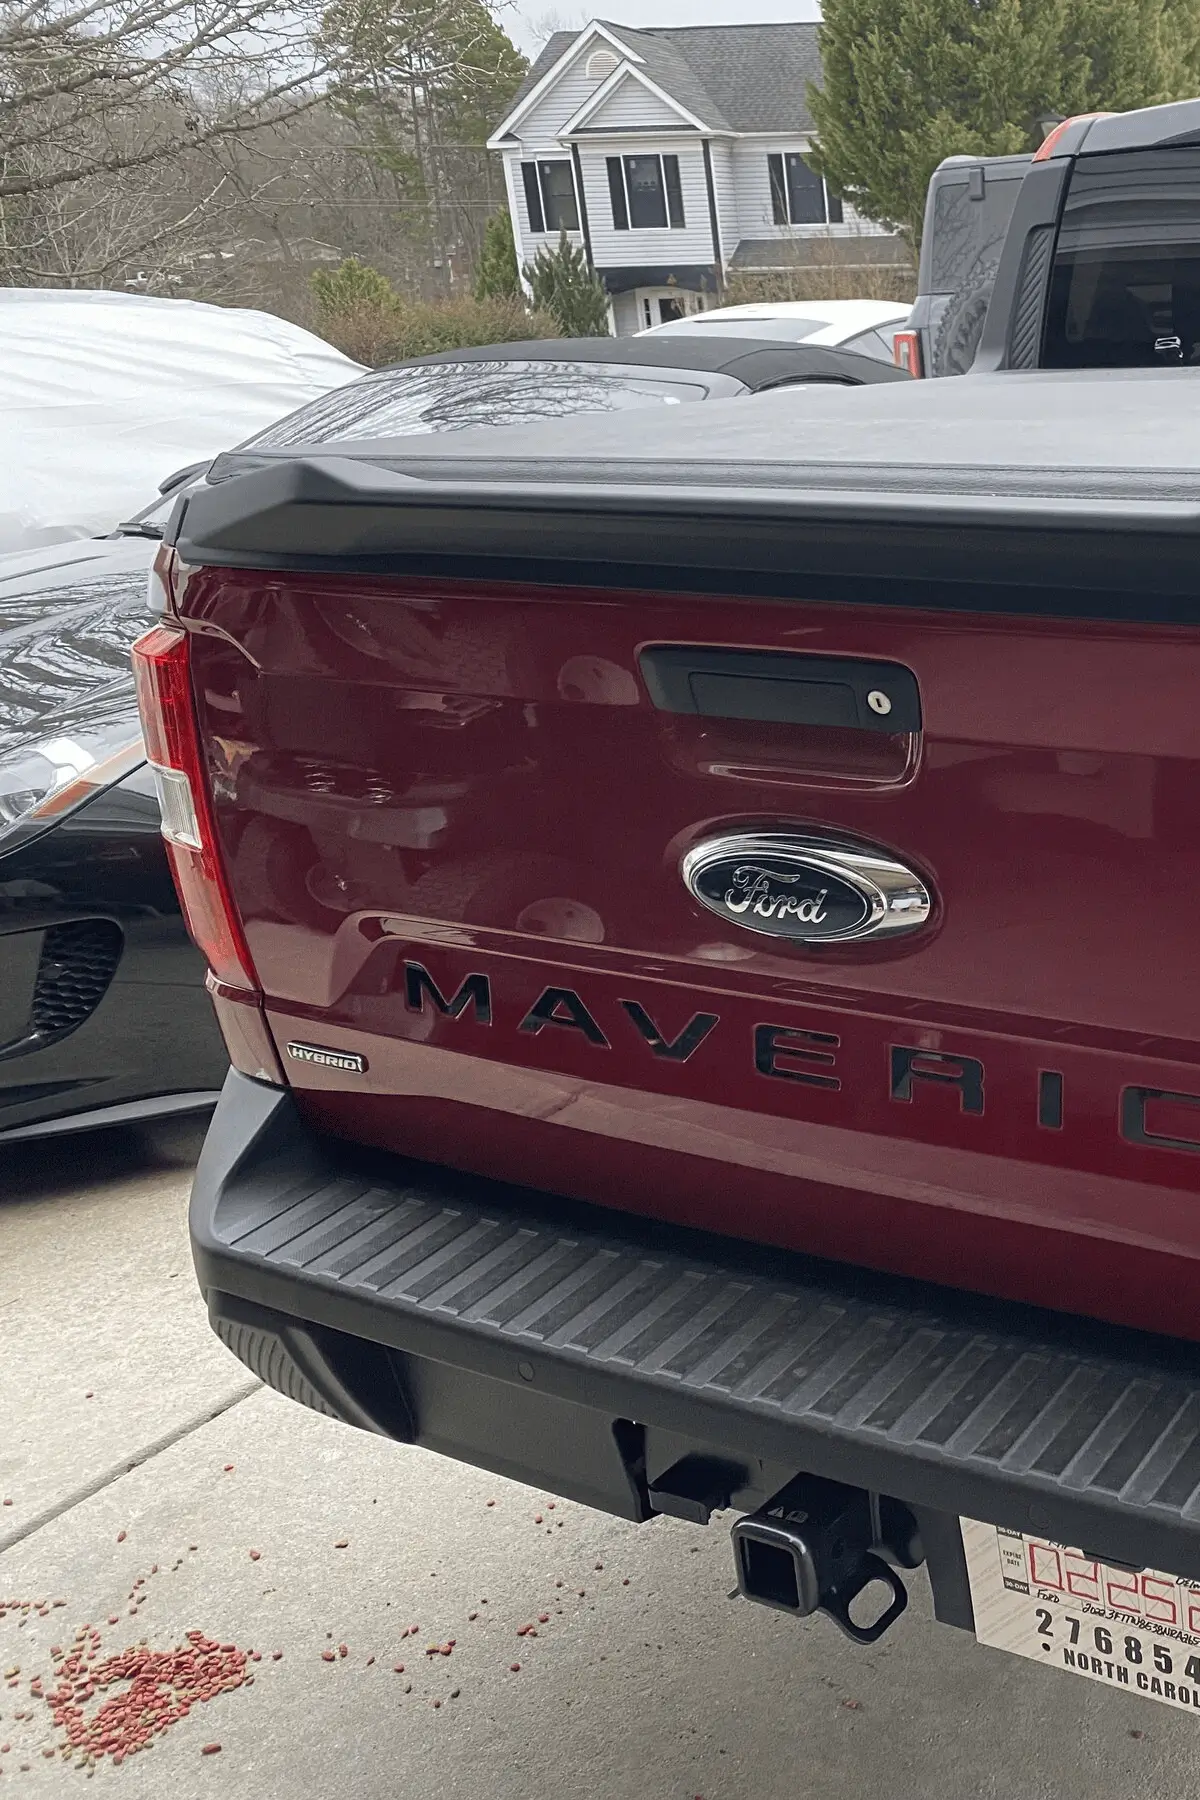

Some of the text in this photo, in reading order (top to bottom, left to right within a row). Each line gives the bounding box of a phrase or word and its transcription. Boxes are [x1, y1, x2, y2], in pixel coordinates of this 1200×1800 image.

[723, 865, 828, 924] Ford
[292, 1047, 357, 1070] HYBRID
[1004, 1579, 1028, 1593] 30-DAY
[1063, 1647, 1129, 1685] NORTH
